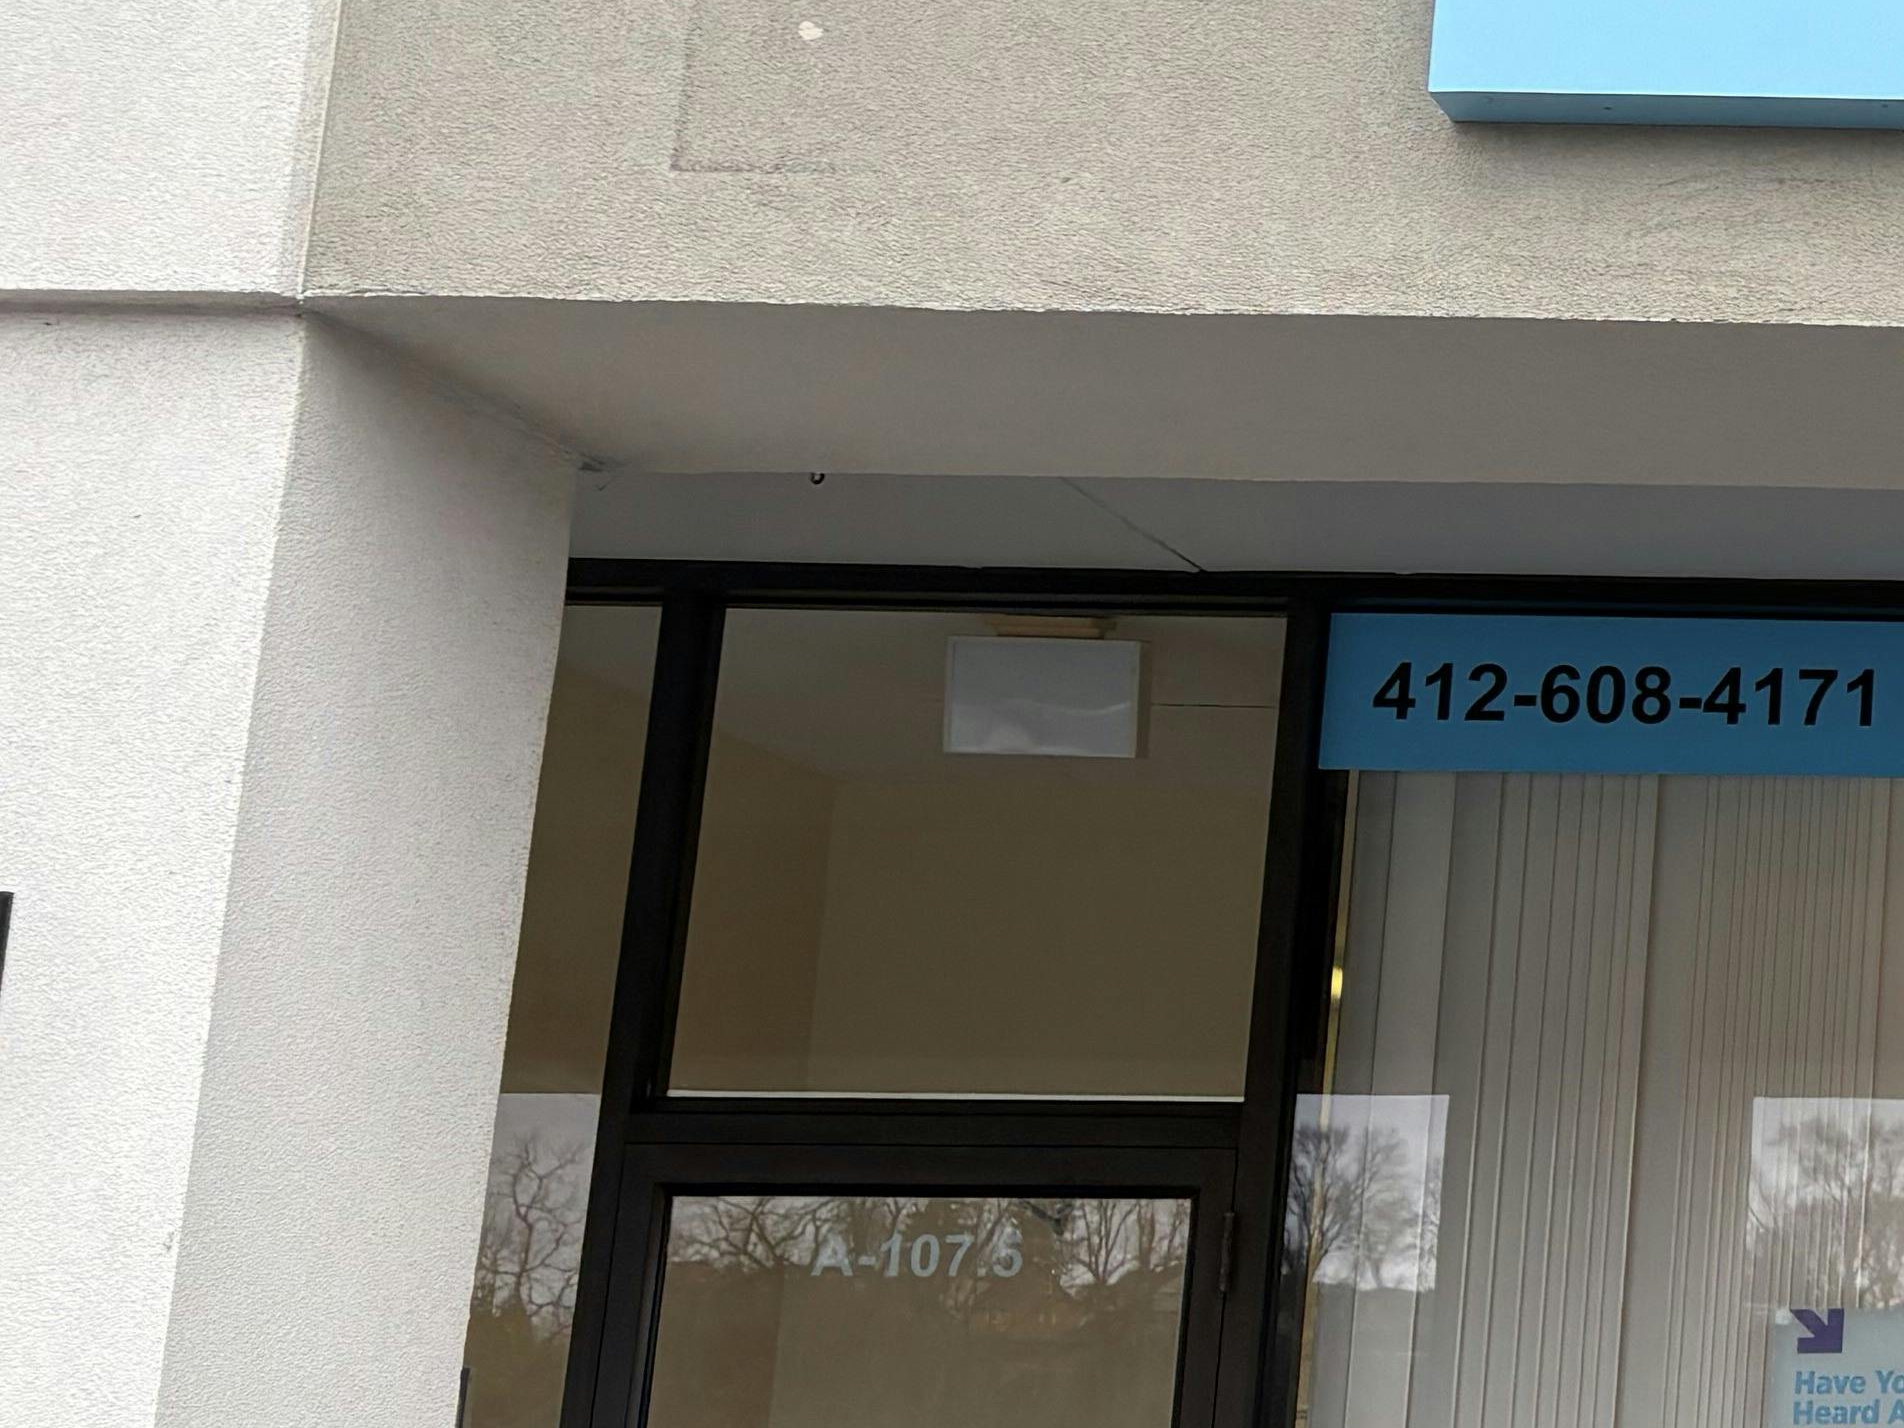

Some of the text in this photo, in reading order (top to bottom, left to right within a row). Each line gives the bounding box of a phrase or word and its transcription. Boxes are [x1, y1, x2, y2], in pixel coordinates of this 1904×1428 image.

[1372, 661, 1878, 728] 412-608-4171
[1795, 1371, 1866, 1395] Have
[1793, 1400, 1880, 1424] Heard
